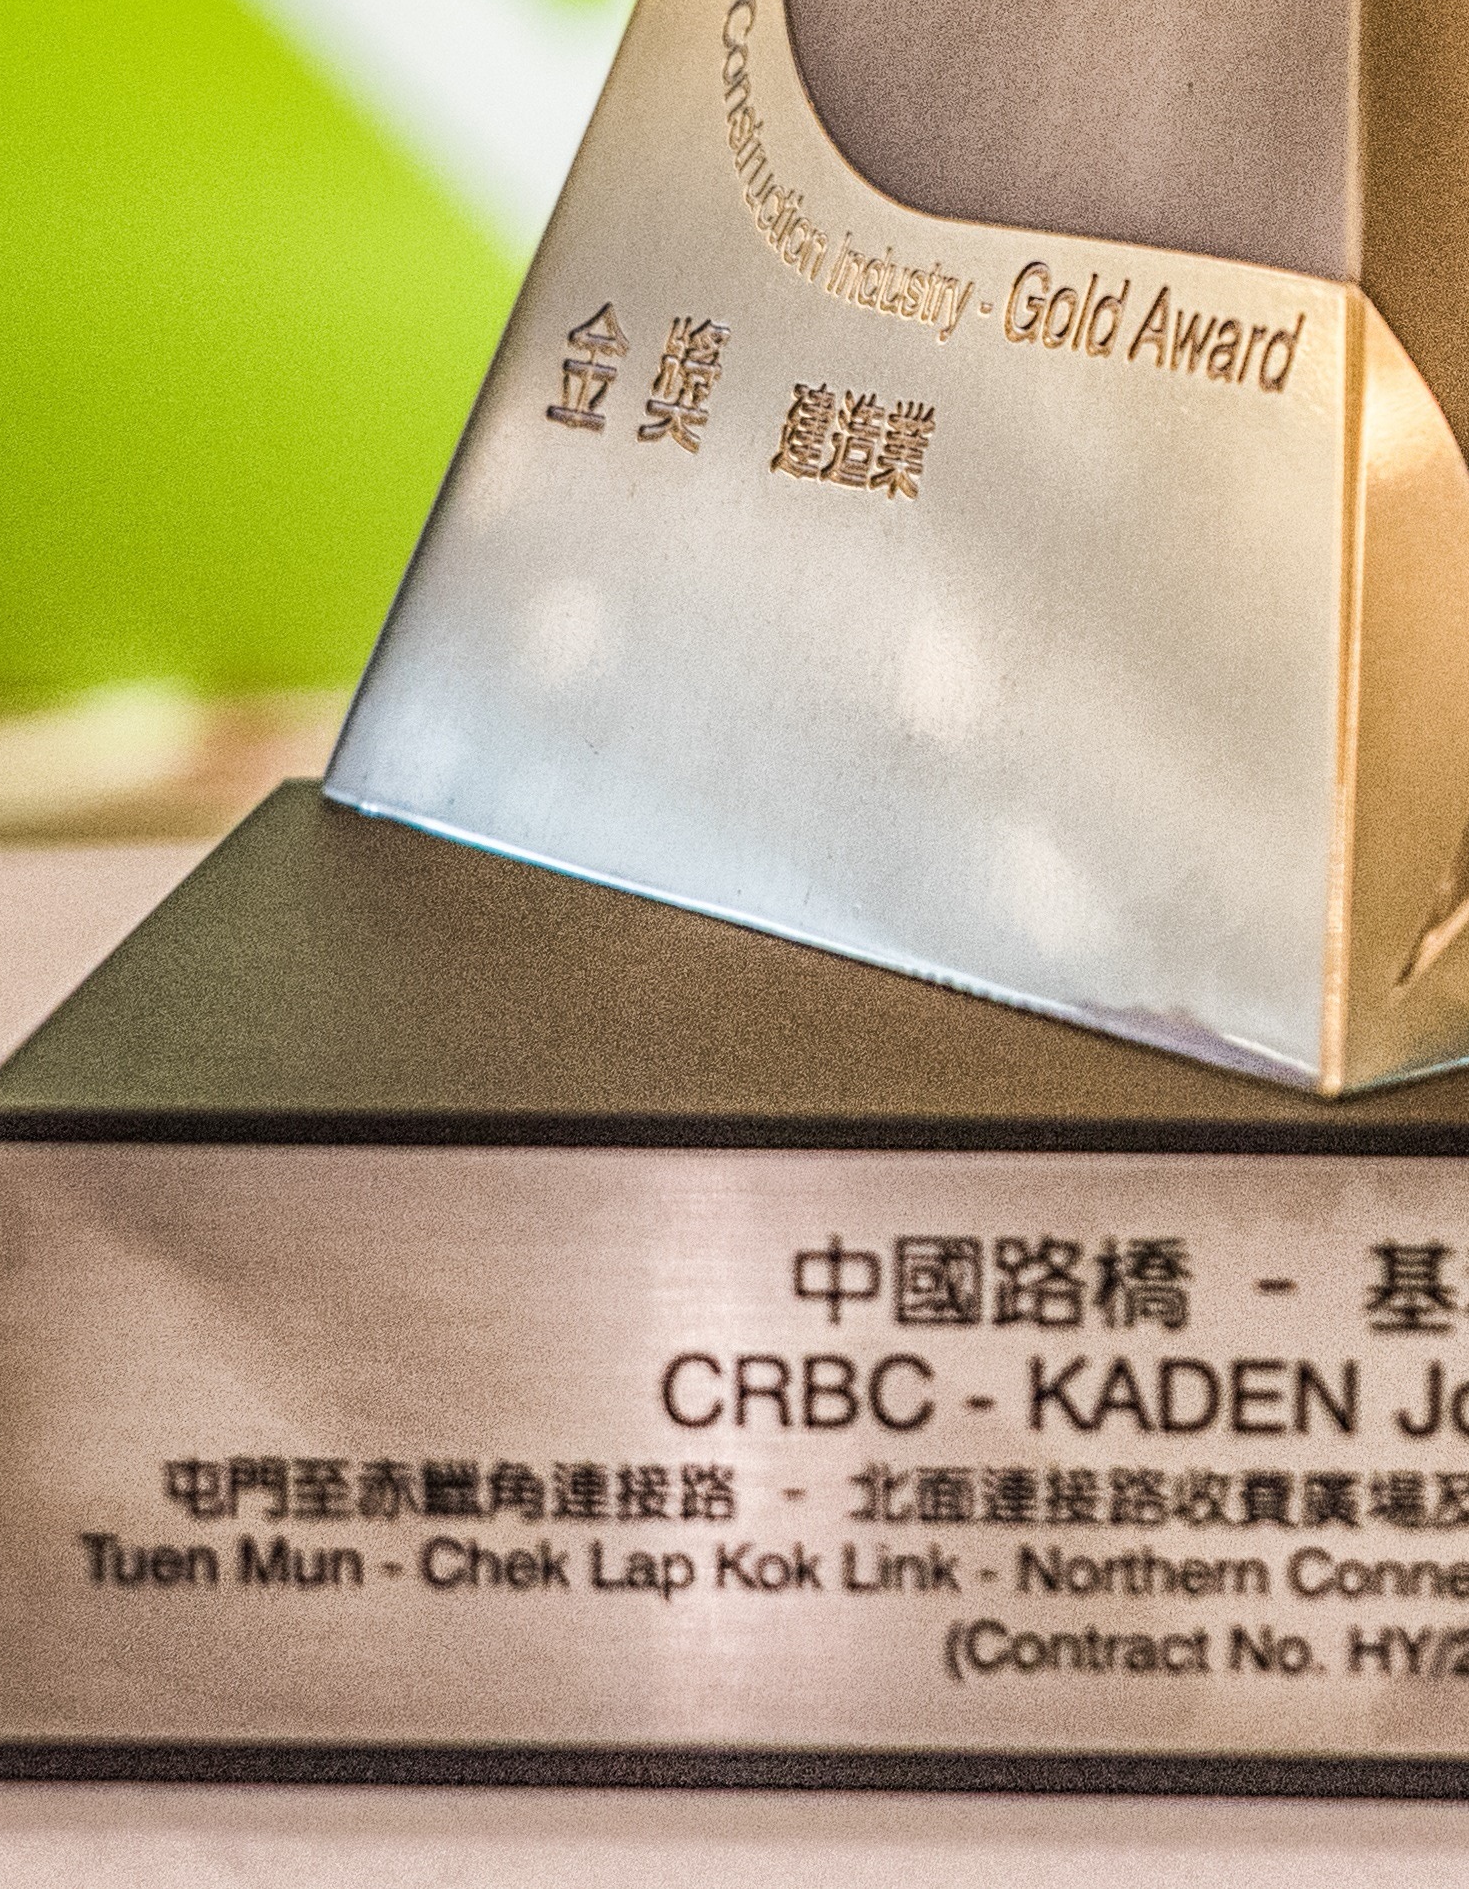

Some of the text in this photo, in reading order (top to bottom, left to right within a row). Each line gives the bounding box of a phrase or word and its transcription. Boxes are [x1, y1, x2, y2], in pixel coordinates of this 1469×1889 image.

[826, 229, 975, 344] Industry
[1004, 260, 1130, 358] Gold
[1128, 284, 1307, 394] Award
[769, 380, 937, 502] 建造業
[790, 1236, 1191, 1332] 中國路橋
[658, 1351, 935, 1434] CRBC
[1029, 1358, 1359, 1435] KADEN
[81, 1531, 219, 1590] Tuen
[237, 1538, 363, 1590] Mun
[419, 1537, 569, 1592] Chek
[590, 1542, 695, 1601] Lap
[716, 1544, 822, 1594] Kok
[841, 1544, 958, 1595] Link
[1018, 1546, 1267, 1597] Northern
[943, 1618, 1209, 1681] (Contract
[1229, 1626, 1324, 1677] No.
